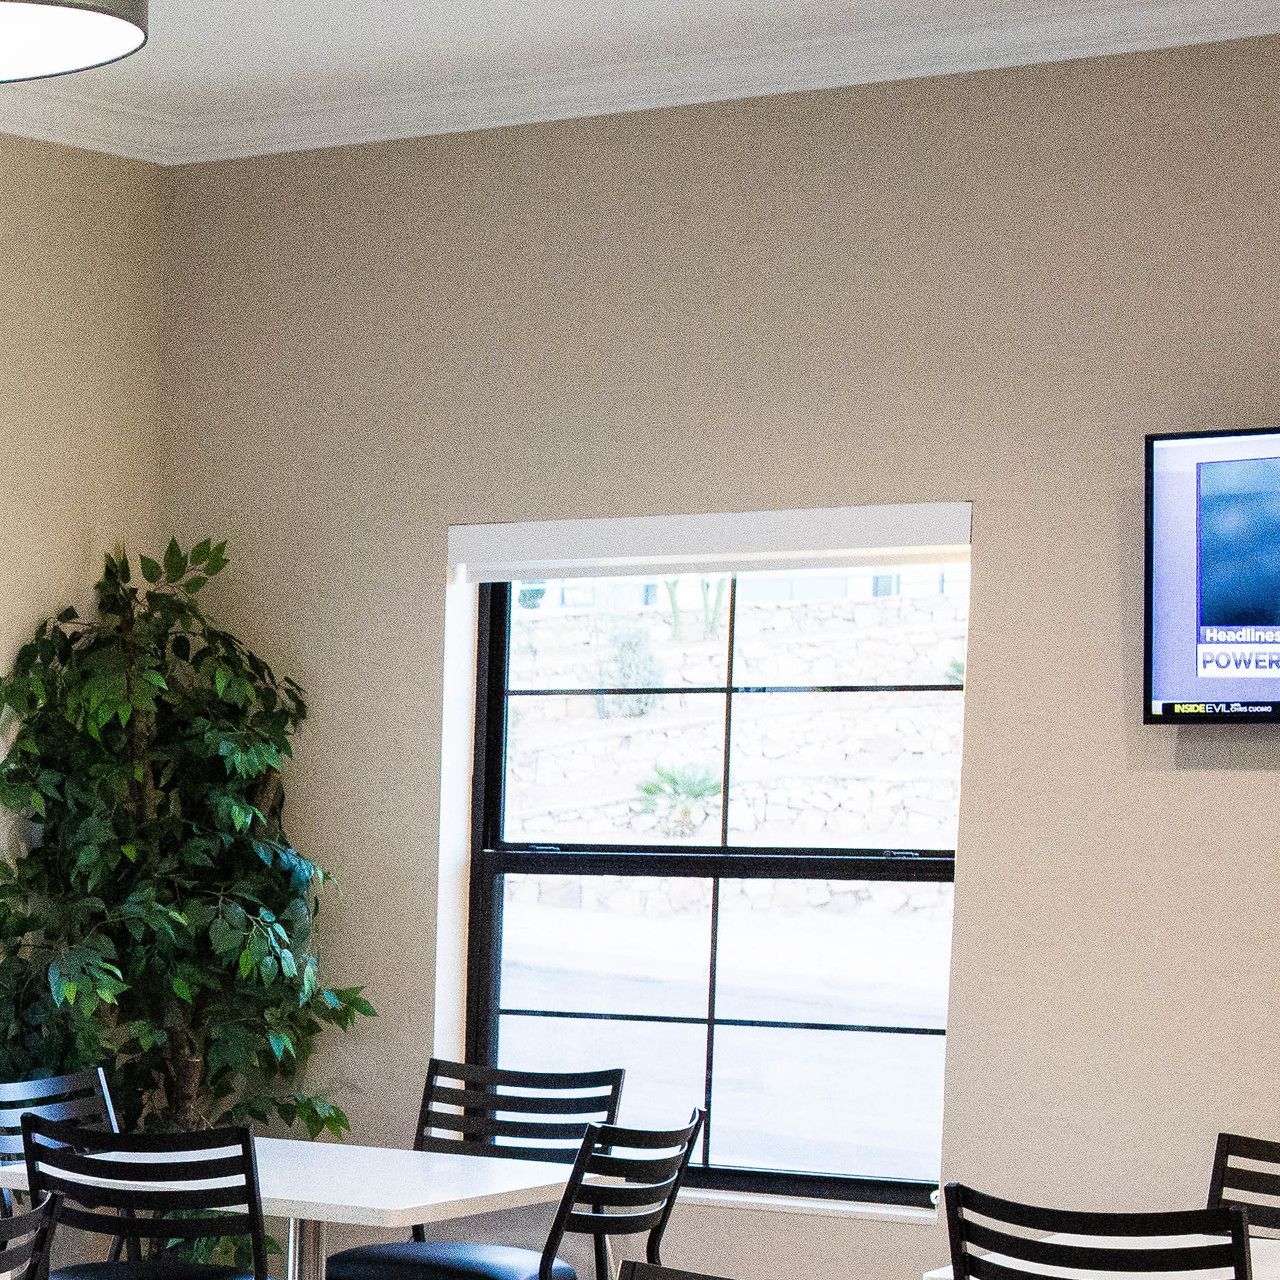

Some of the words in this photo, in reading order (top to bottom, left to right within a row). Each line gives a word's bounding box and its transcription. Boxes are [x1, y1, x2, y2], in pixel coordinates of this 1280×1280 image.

[1205, 628, 1280, 642] Headlines
[1202, 651, 1280, 669] POWER
[1174, 703, 1205, 713] INSIDE
[1206, 703, 1230, 713] EVIL
